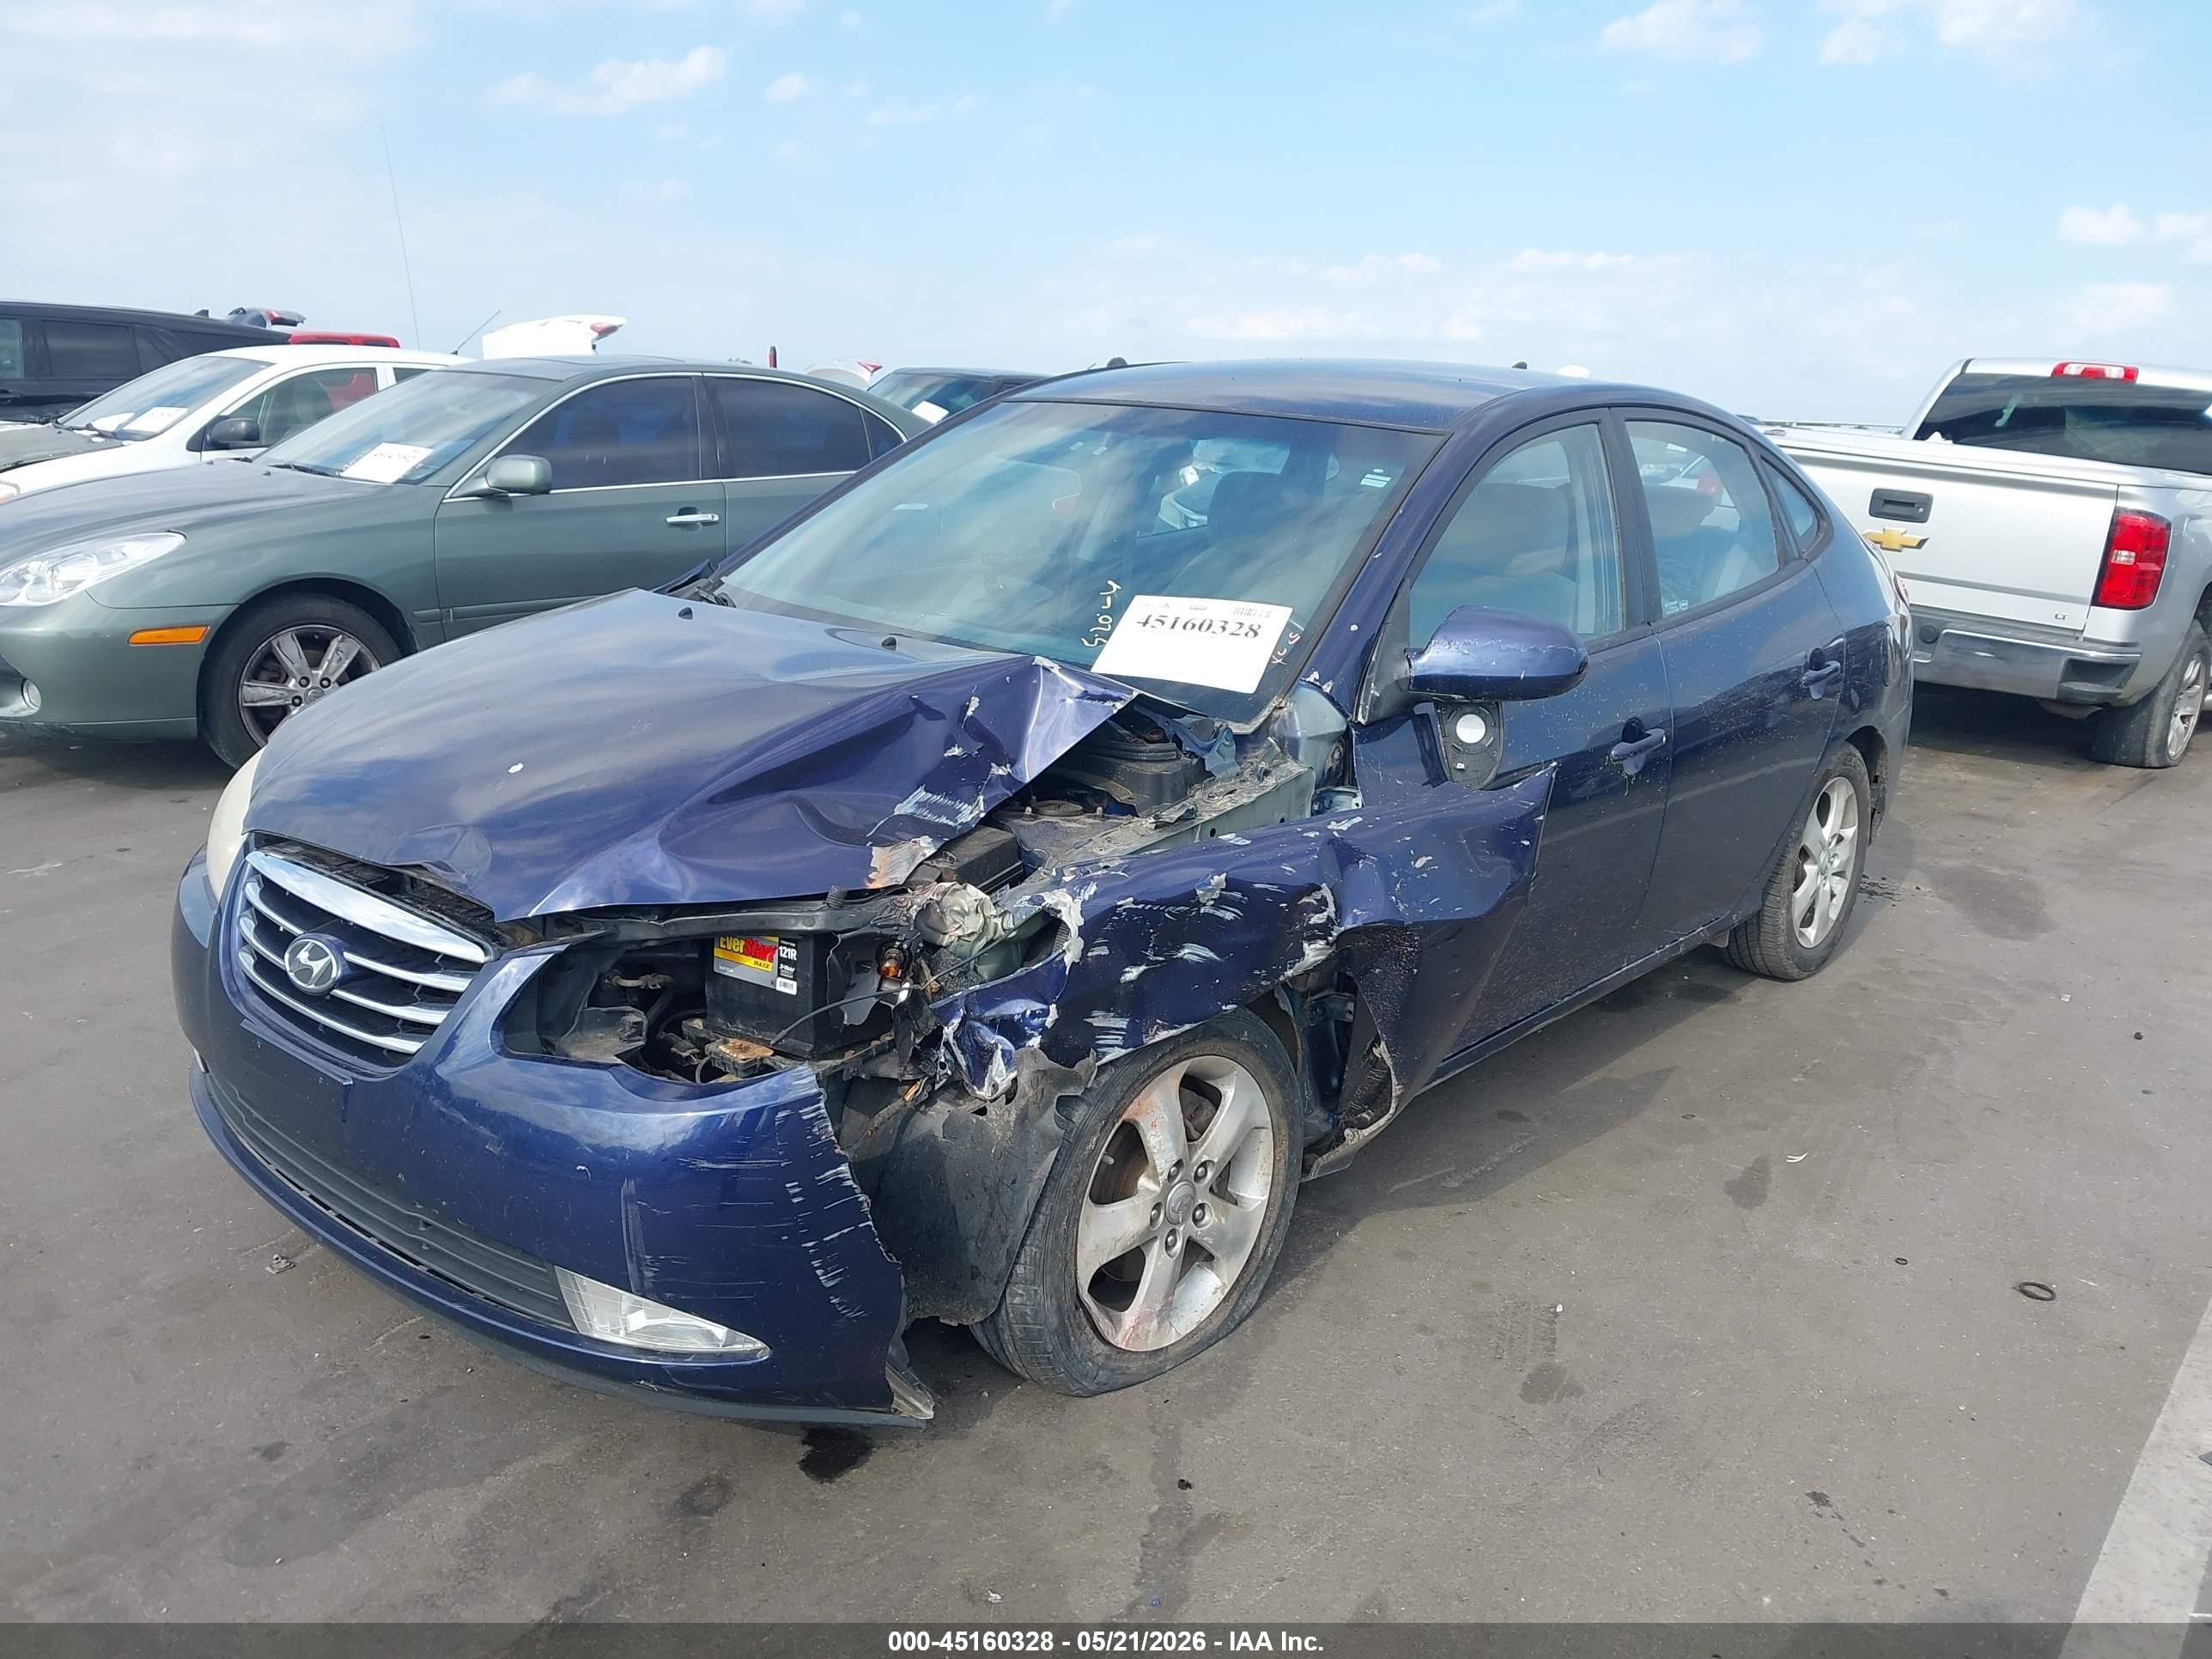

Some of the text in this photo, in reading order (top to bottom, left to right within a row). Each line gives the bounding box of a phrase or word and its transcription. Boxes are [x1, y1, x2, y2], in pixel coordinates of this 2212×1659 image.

[1135, 613, 1263, 639] 45160328
[719, 936, 777, 963] EverStart
[778, 945, 798, 961] 121R
[753, 959, 771, 969] MAXX
